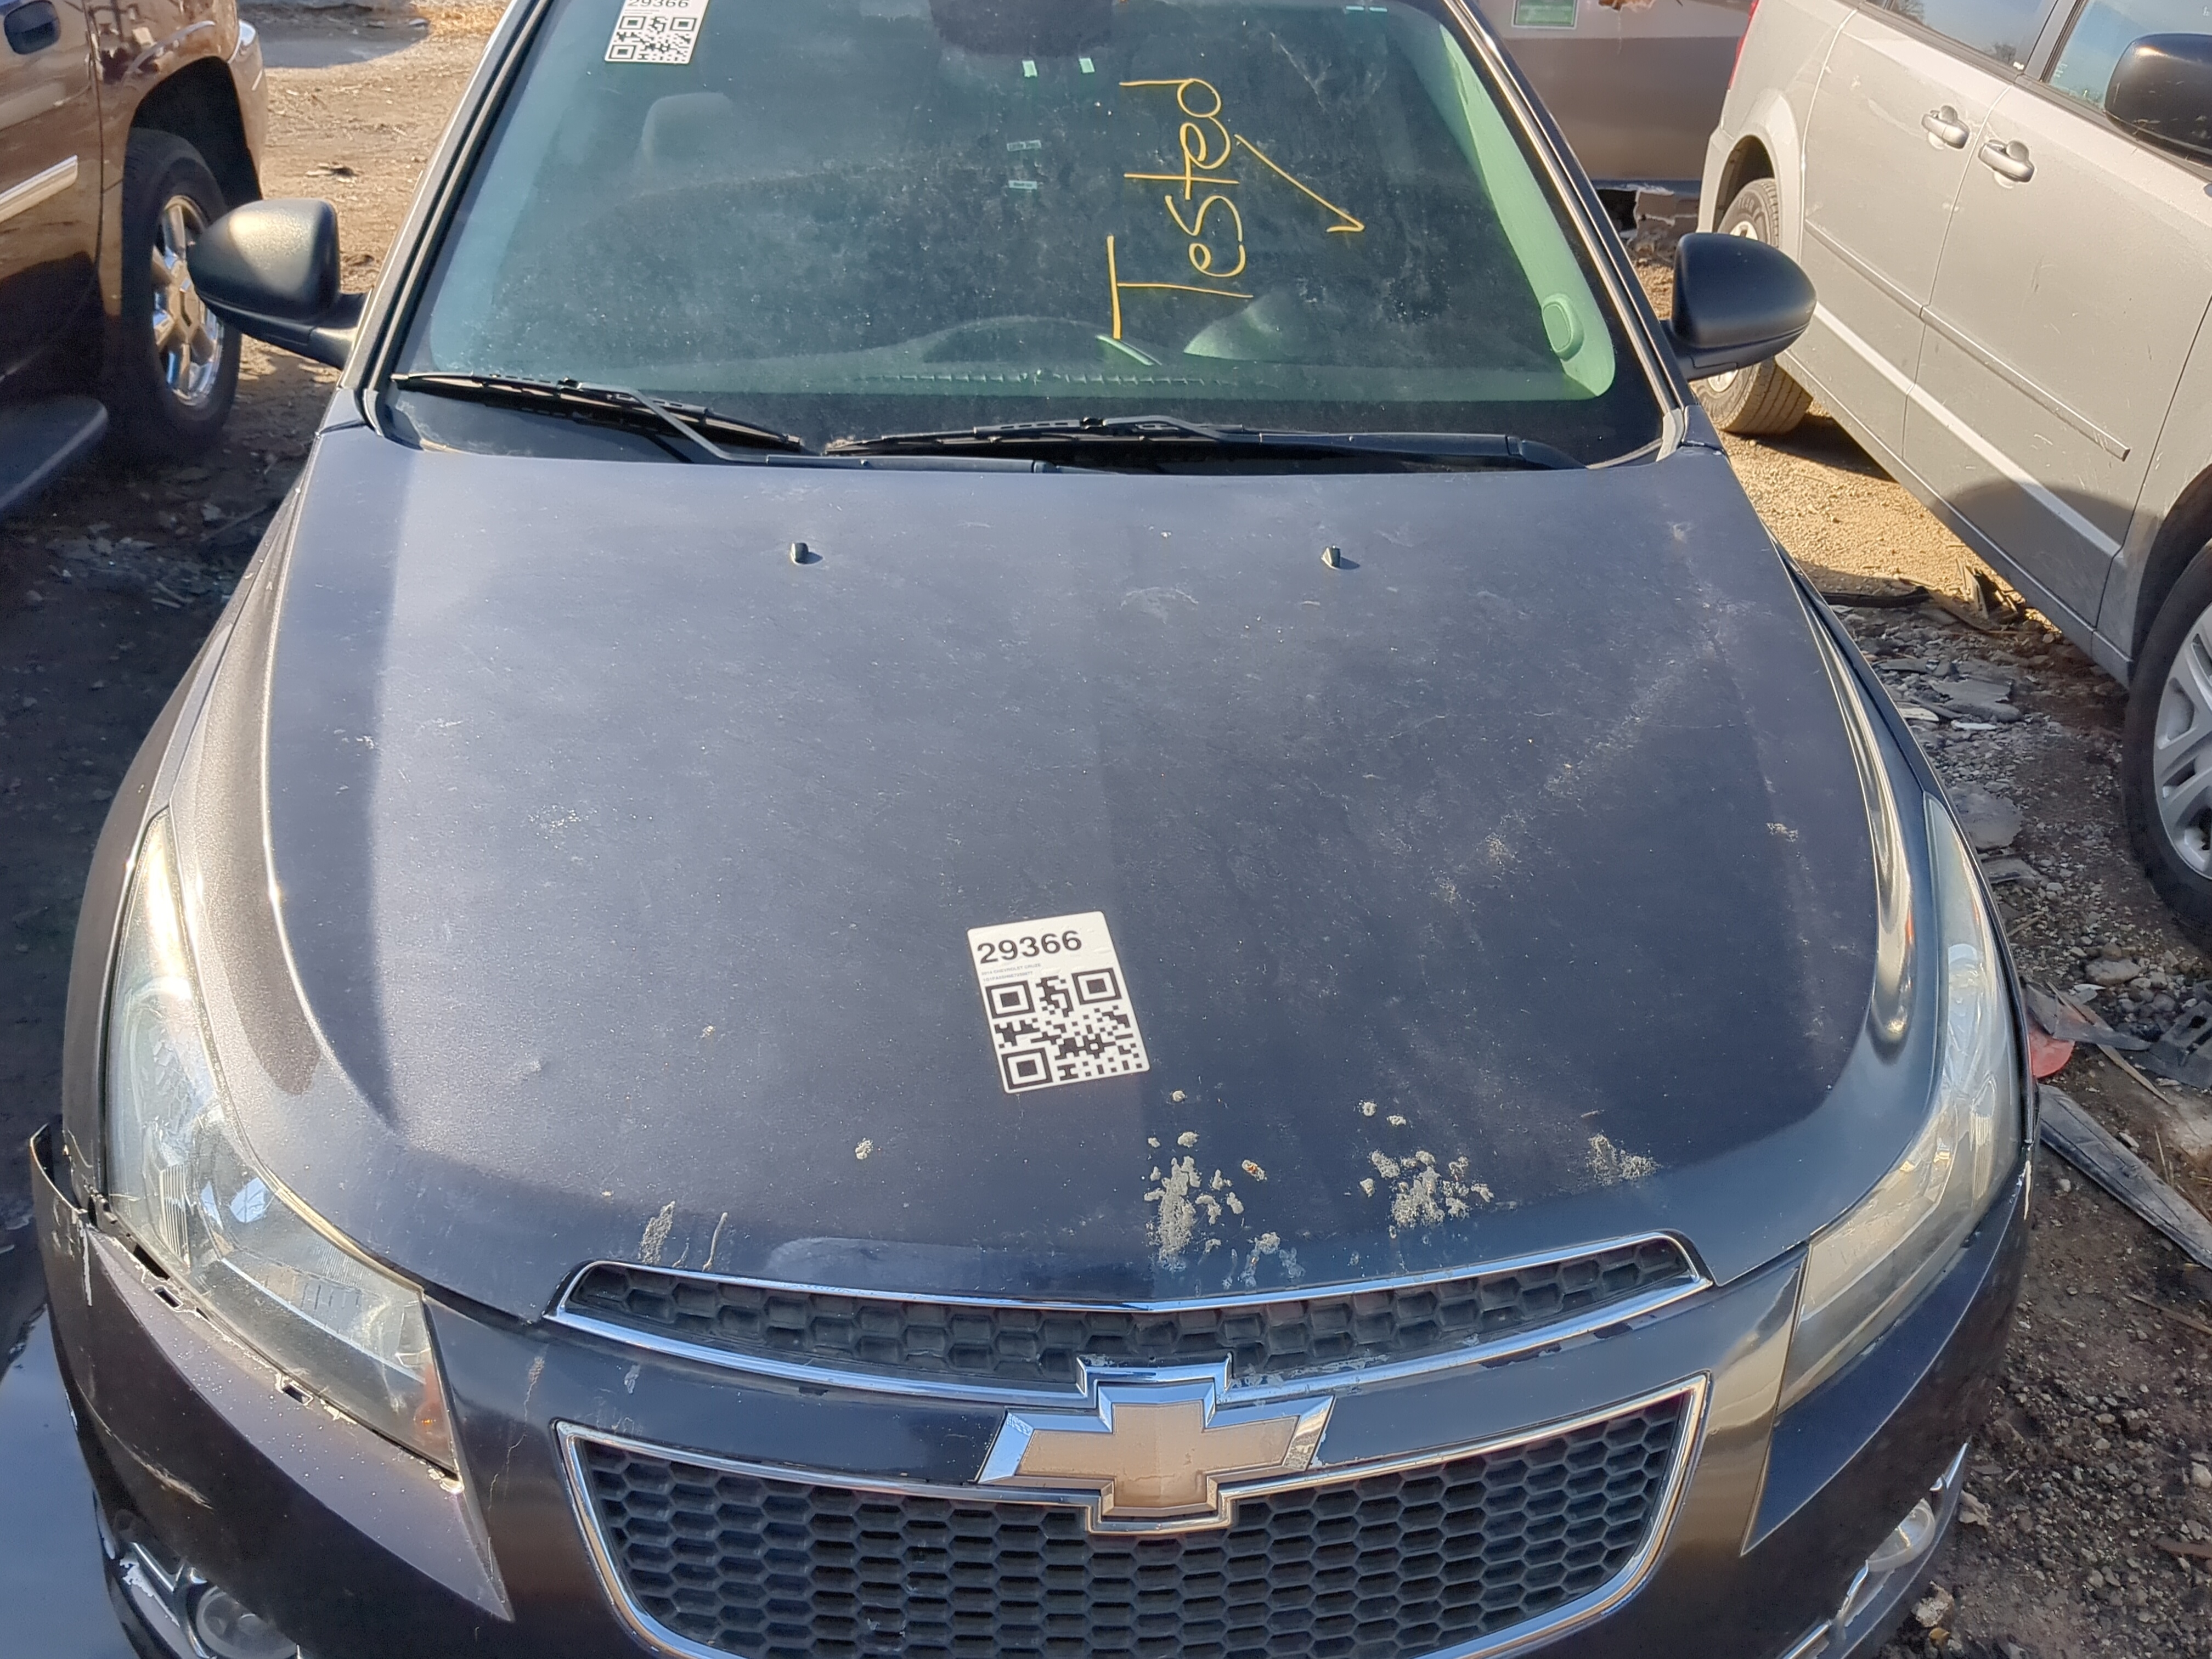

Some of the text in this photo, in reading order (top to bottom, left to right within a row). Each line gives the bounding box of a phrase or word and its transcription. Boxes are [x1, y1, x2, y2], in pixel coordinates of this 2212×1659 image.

[1106, 77, 1254, 340] Tested
[977, 930, 1082, 964] 29366
[993, 966, 1023, 974] CHEVROLET
